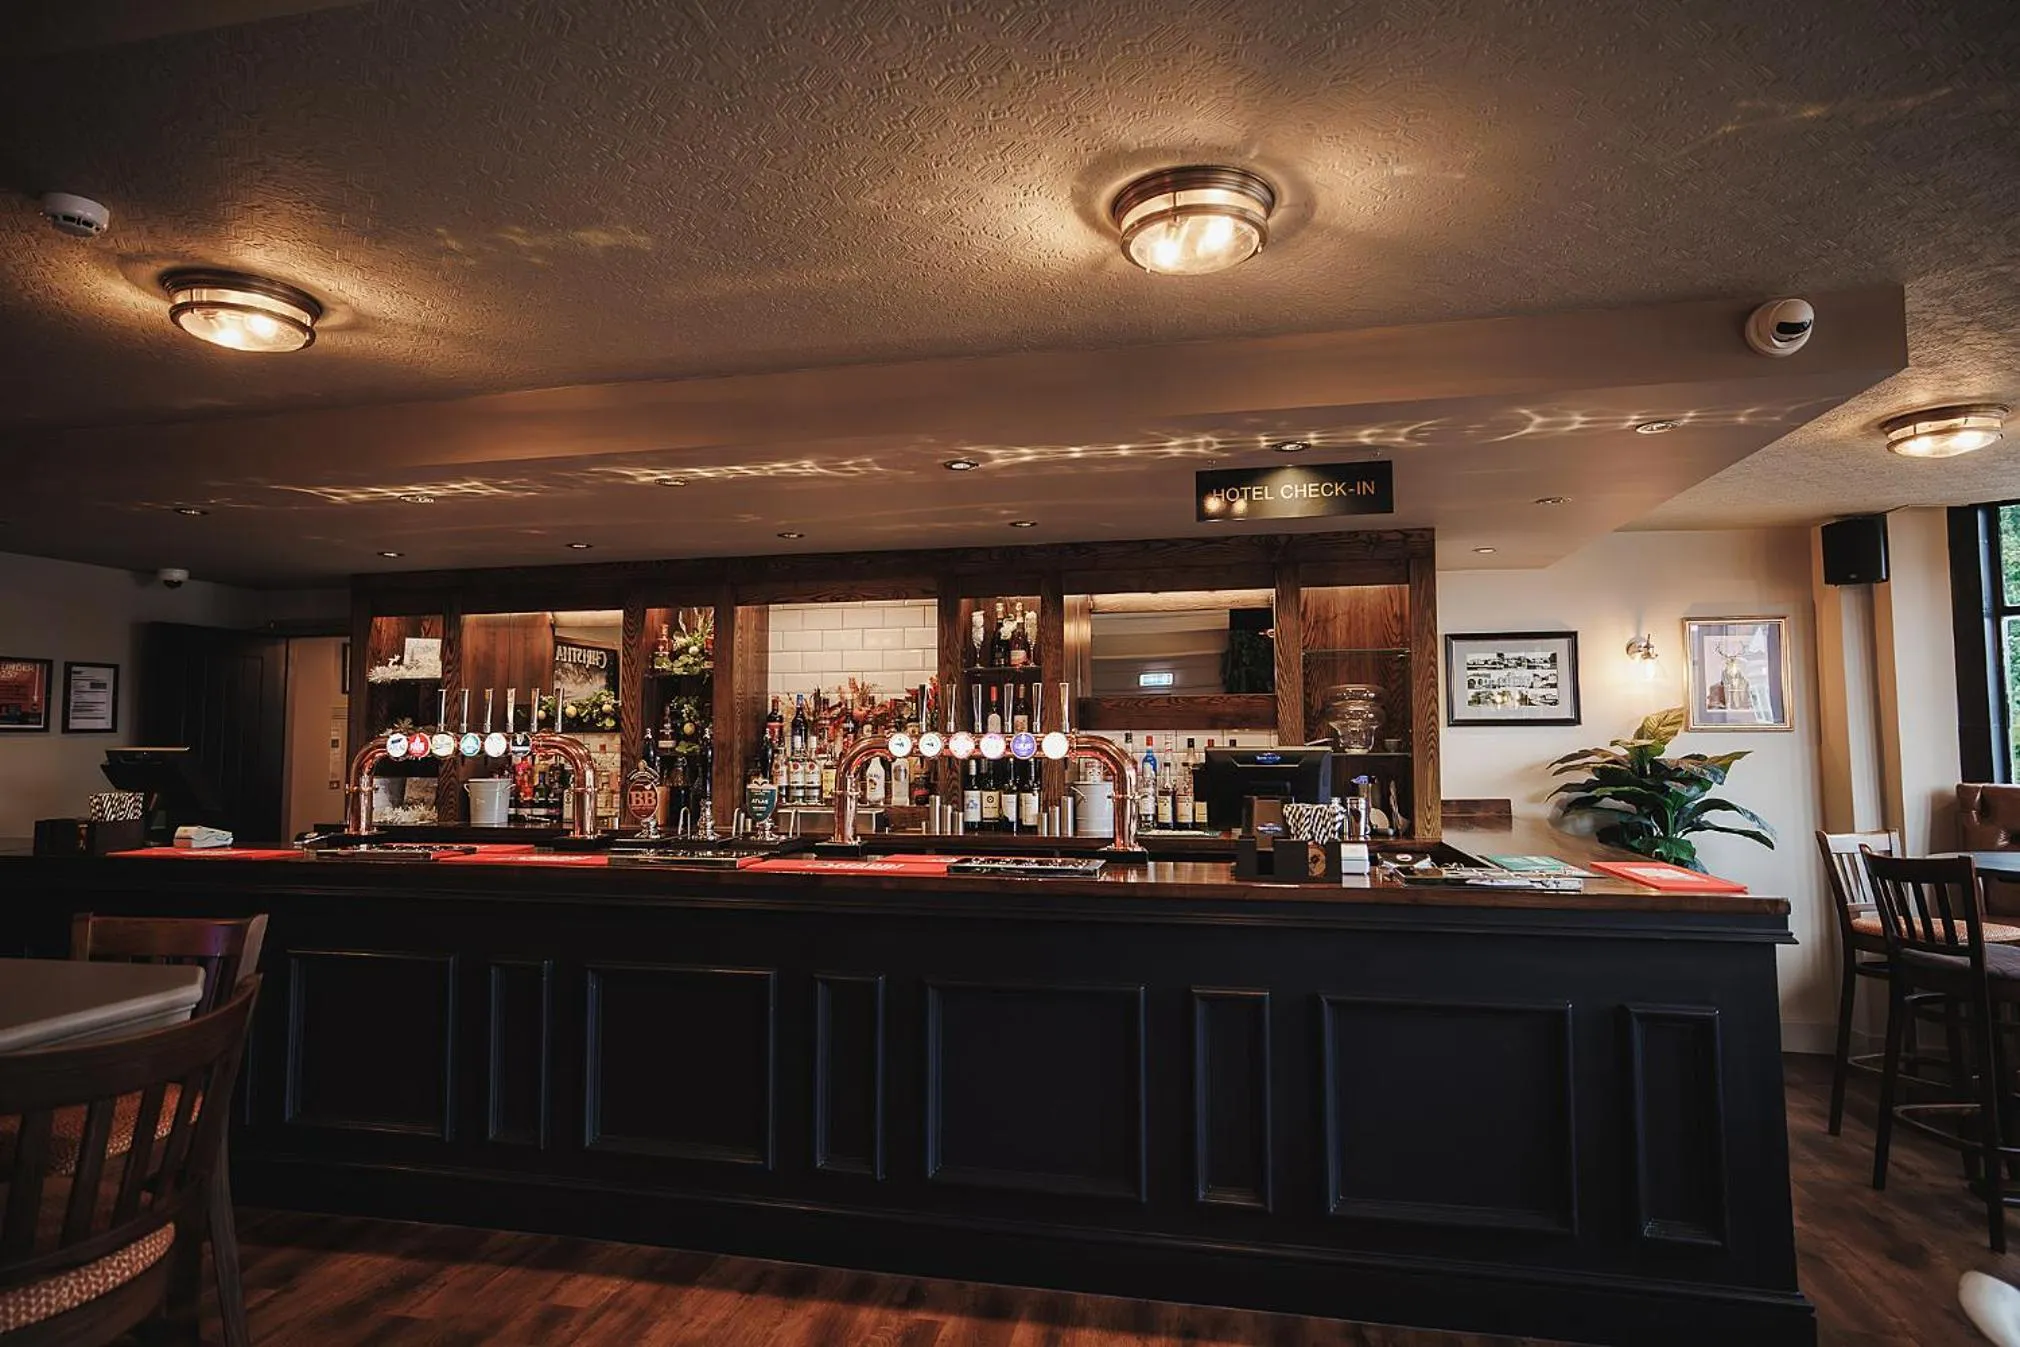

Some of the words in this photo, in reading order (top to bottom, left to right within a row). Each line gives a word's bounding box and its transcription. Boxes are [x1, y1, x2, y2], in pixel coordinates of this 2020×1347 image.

[1213, 487, 1274, 502] HOTEL
[1280, 480, 1376, 499] CHECK-IN
[630, 790, 657, 807] BB
